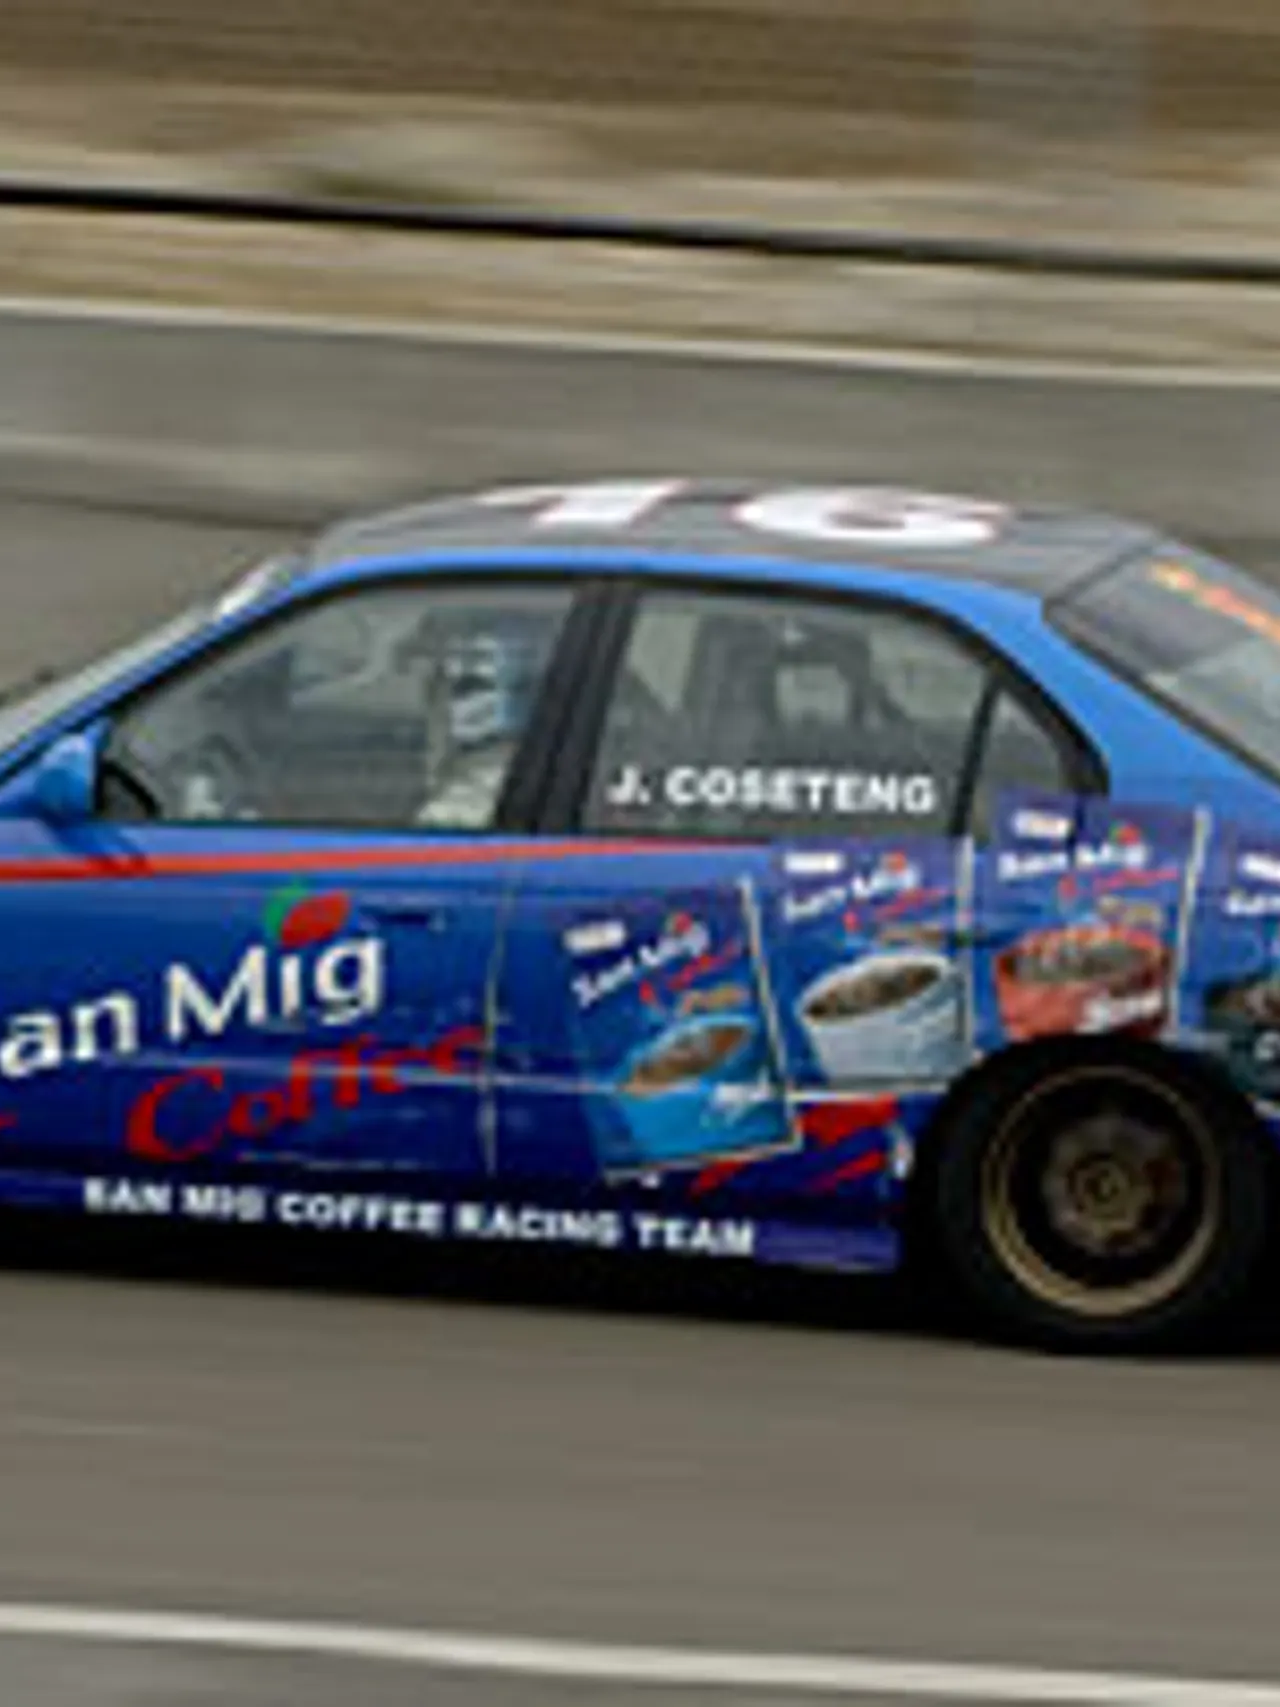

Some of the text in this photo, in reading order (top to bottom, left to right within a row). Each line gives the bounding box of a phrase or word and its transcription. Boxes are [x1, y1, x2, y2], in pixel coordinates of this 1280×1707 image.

[475, 478, 1011, 549] 16
[606, 765, 937, 814] J. COSETENG
[165, 937, 386, 1040] Mig
[125, 1027, 487, 1161] Coffee
[84, 1177, 756, 1256] SAN MIG COFFEE RACING TEAM
